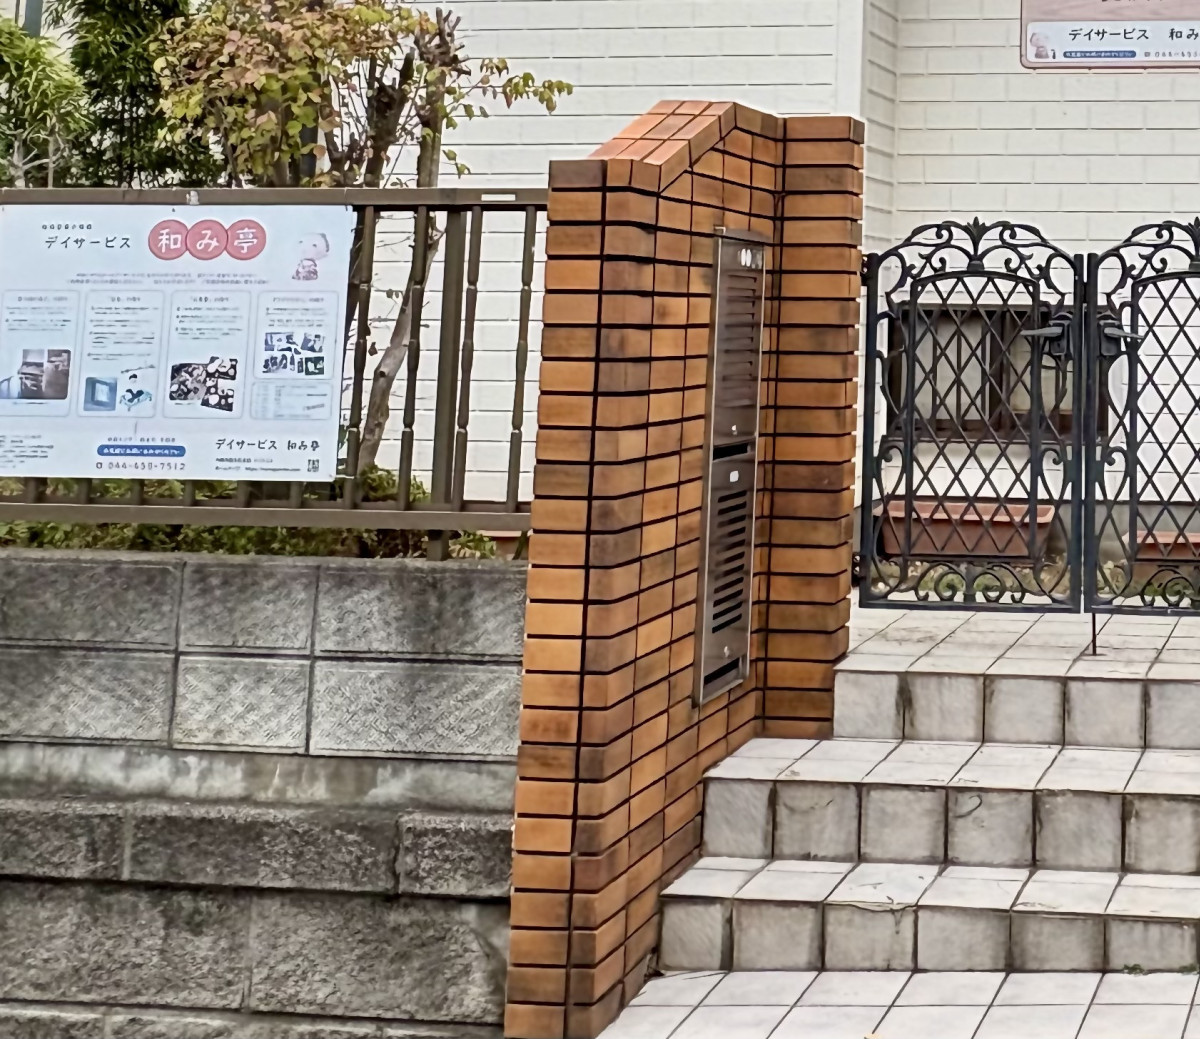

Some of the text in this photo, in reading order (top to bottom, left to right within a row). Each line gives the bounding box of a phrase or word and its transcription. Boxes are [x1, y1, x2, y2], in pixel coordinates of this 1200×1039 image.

[1069, 27, 1150, 41] デイサービス
[45, 228, 258, 253] デイサービス 和み亭
[215, 438, 278, 450] デイサービス
